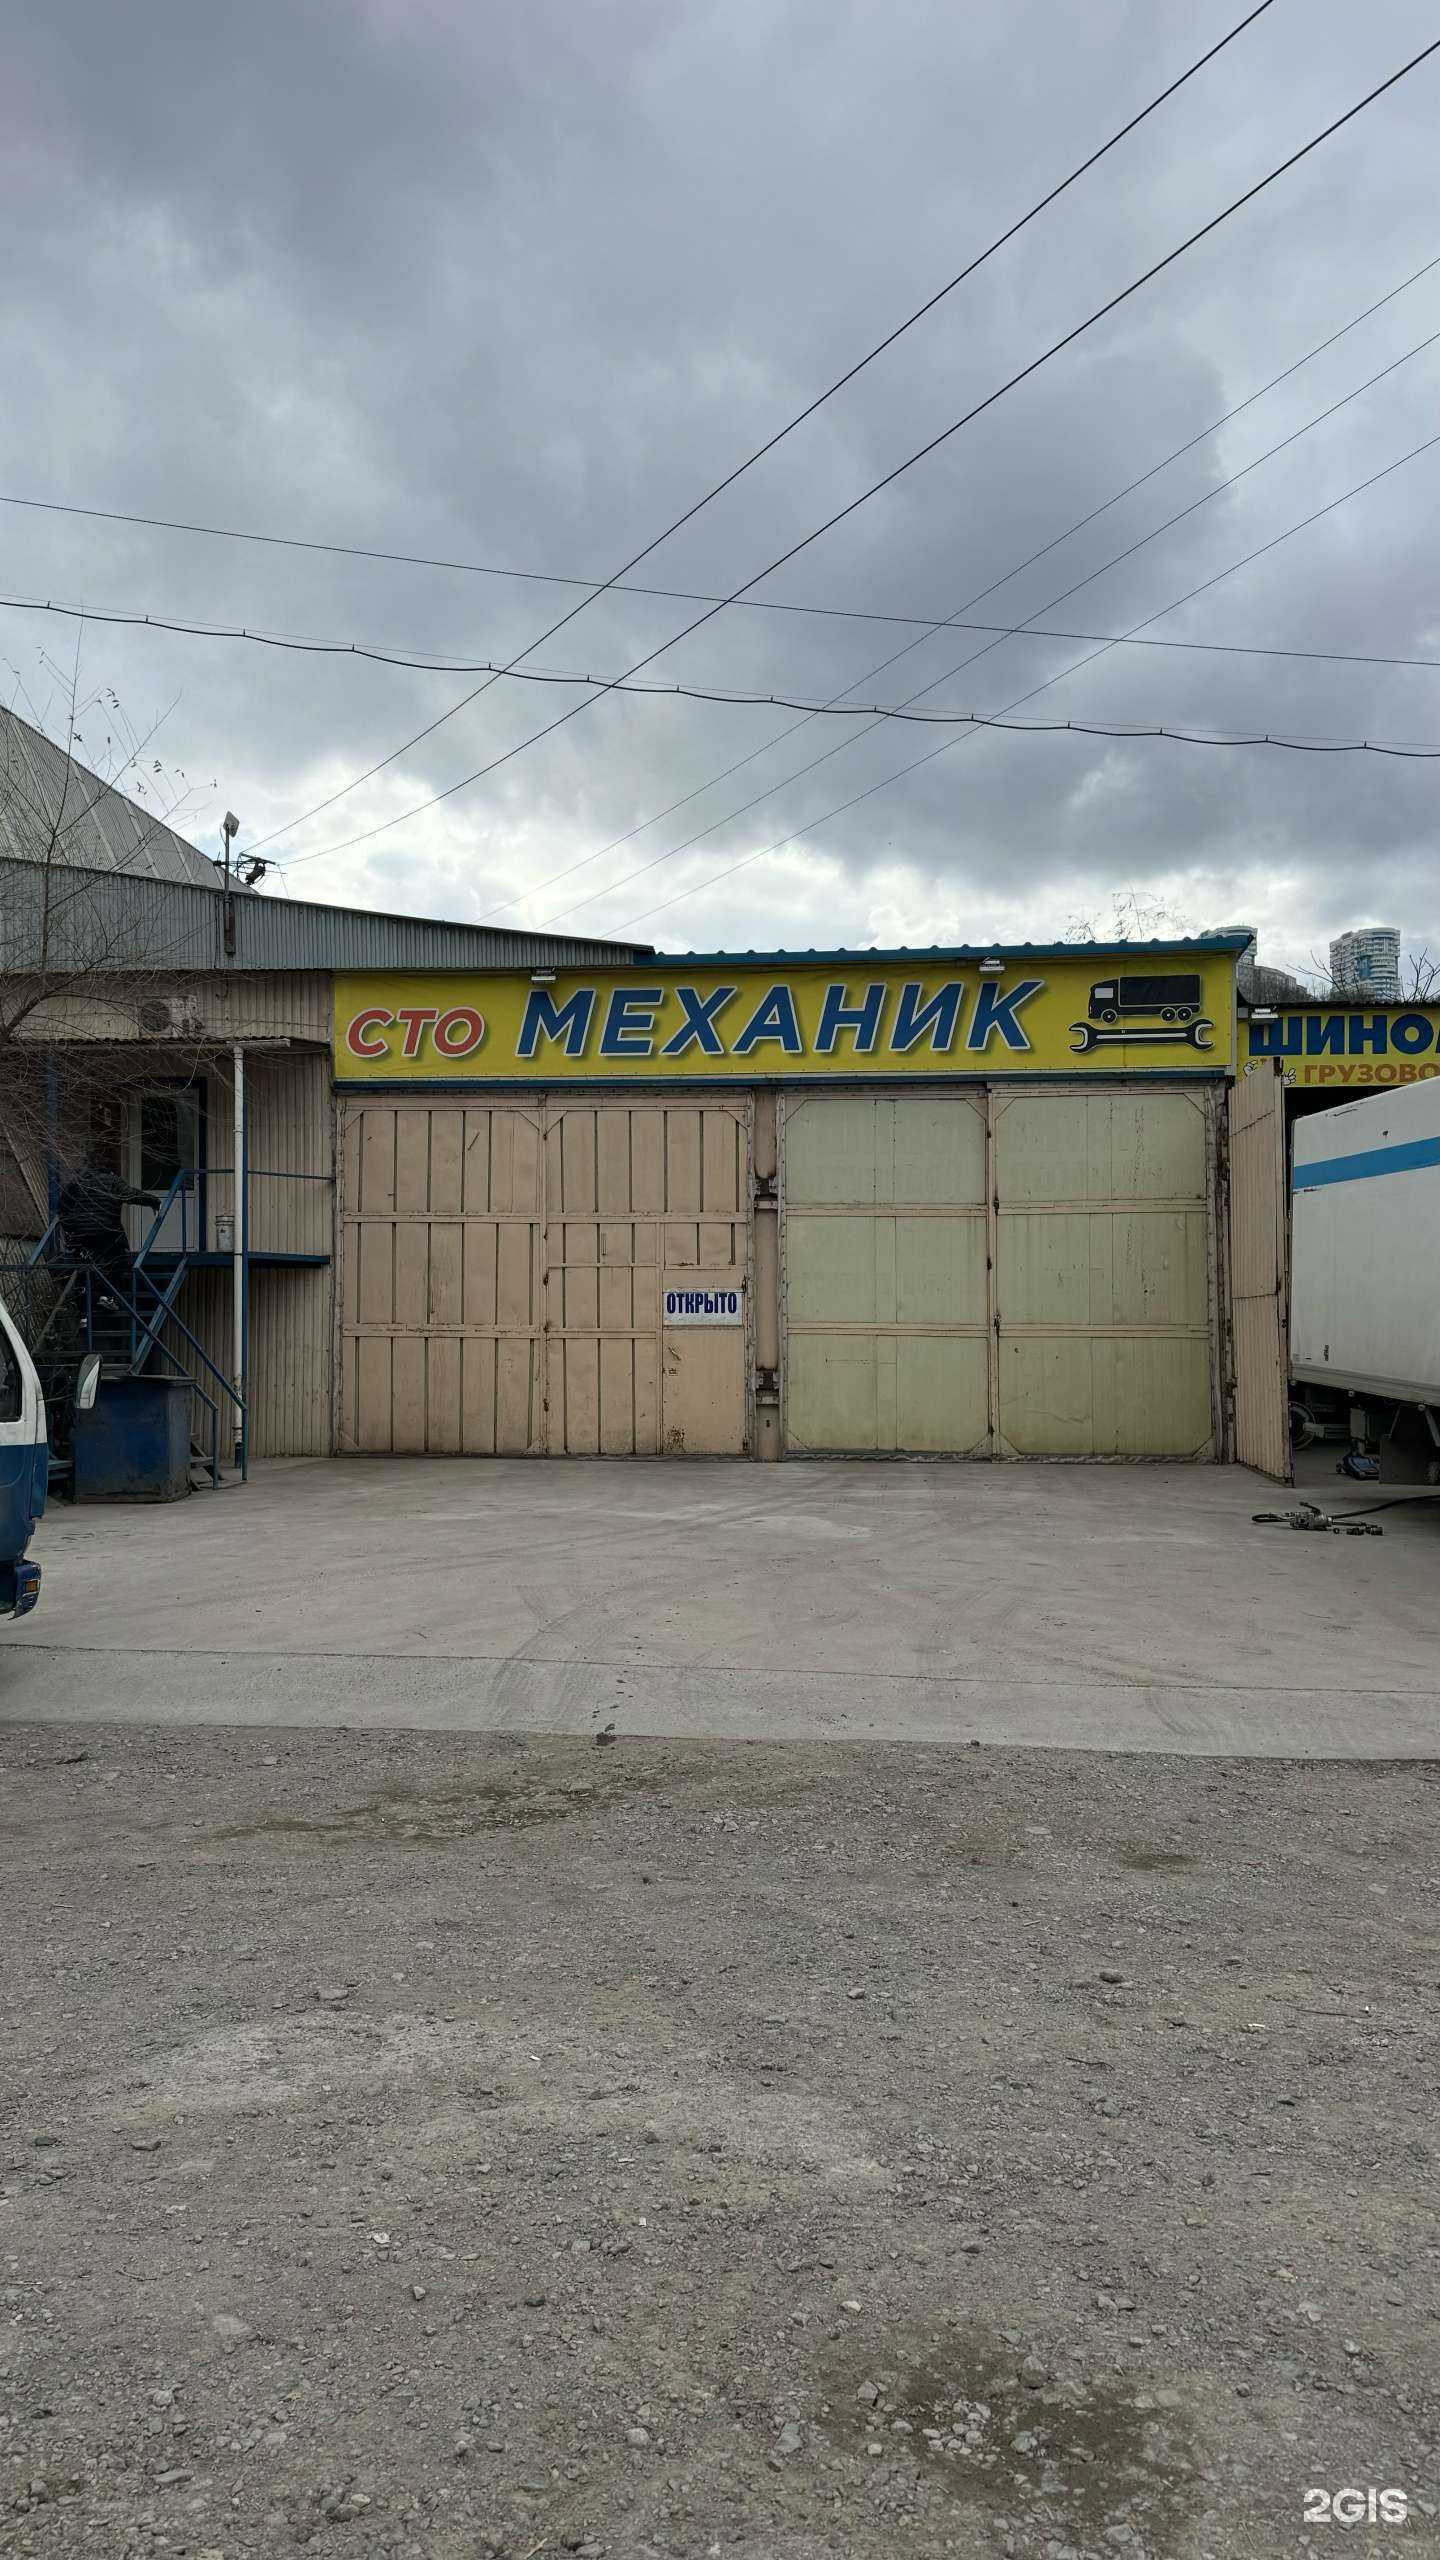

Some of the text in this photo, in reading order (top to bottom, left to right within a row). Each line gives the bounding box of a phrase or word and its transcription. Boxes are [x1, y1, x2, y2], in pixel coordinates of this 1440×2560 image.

[346, 979, 1046, 1058] СТО МЕХАНИК
[1249, 1013, 1440, 1056] ШИНО
[666, 1292, 737, 1314] ОТКРЫТО
